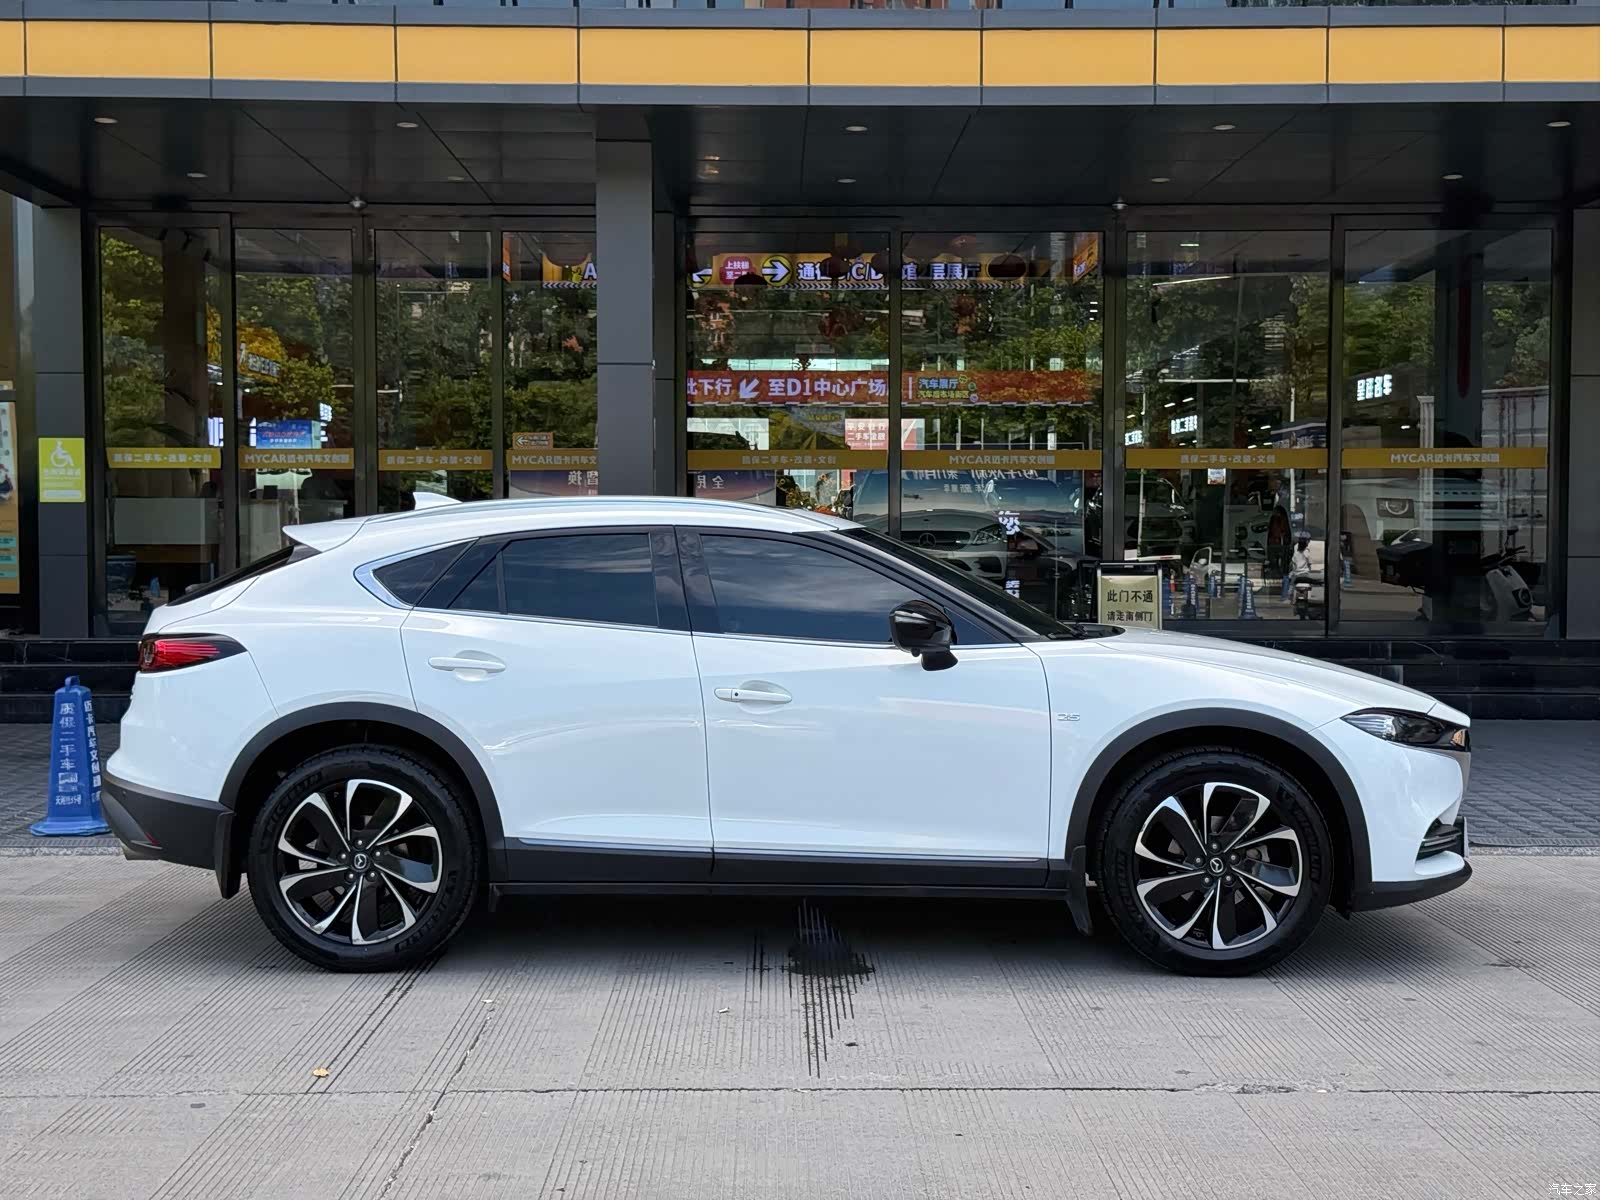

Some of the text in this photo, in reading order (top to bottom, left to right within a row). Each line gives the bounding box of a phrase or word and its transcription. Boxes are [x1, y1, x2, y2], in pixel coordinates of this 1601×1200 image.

[919, 378, 959, 389] 汽车展厅
[1107, 589, 1154, 603] 此门不通
[1107, 611, 1154, 622] 请走南侧门
[60, 702, 76, 771] 质保二手车
